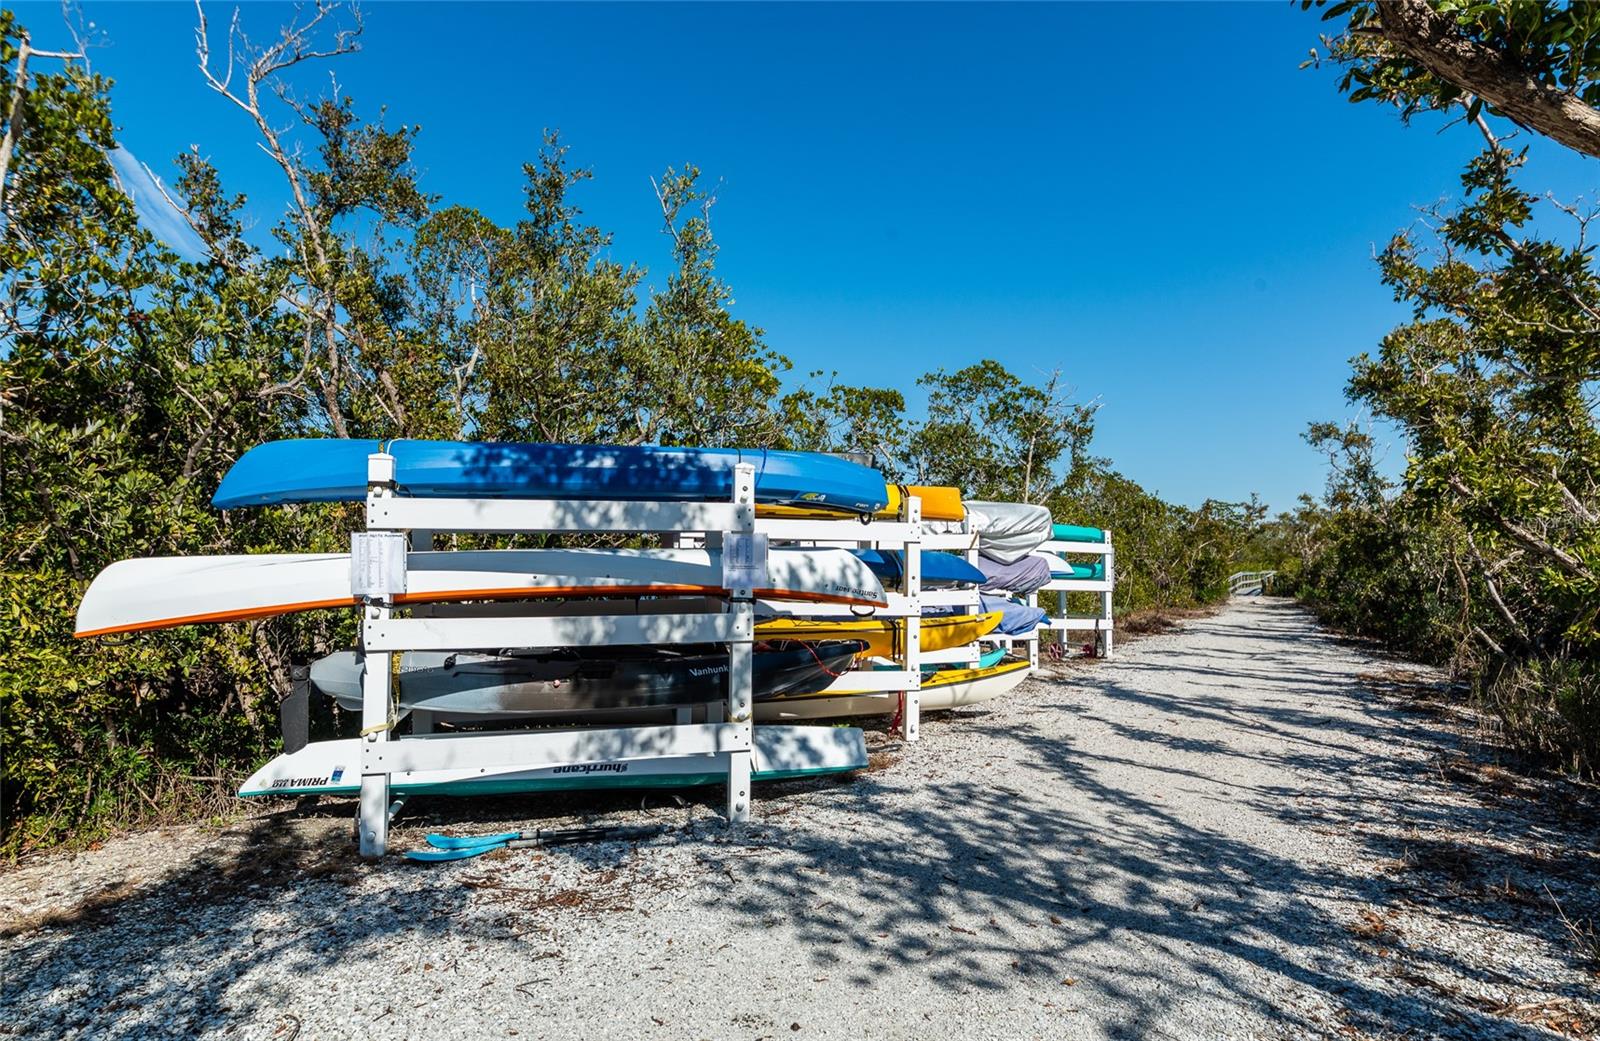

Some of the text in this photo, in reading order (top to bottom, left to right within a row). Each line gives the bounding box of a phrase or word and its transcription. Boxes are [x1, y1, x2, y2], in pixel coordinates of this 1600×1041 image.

[851, 588, 878, 600] Santee
[553, 763, 622, 775] hurricane
[290, 777, 329, 787] PRIMA
